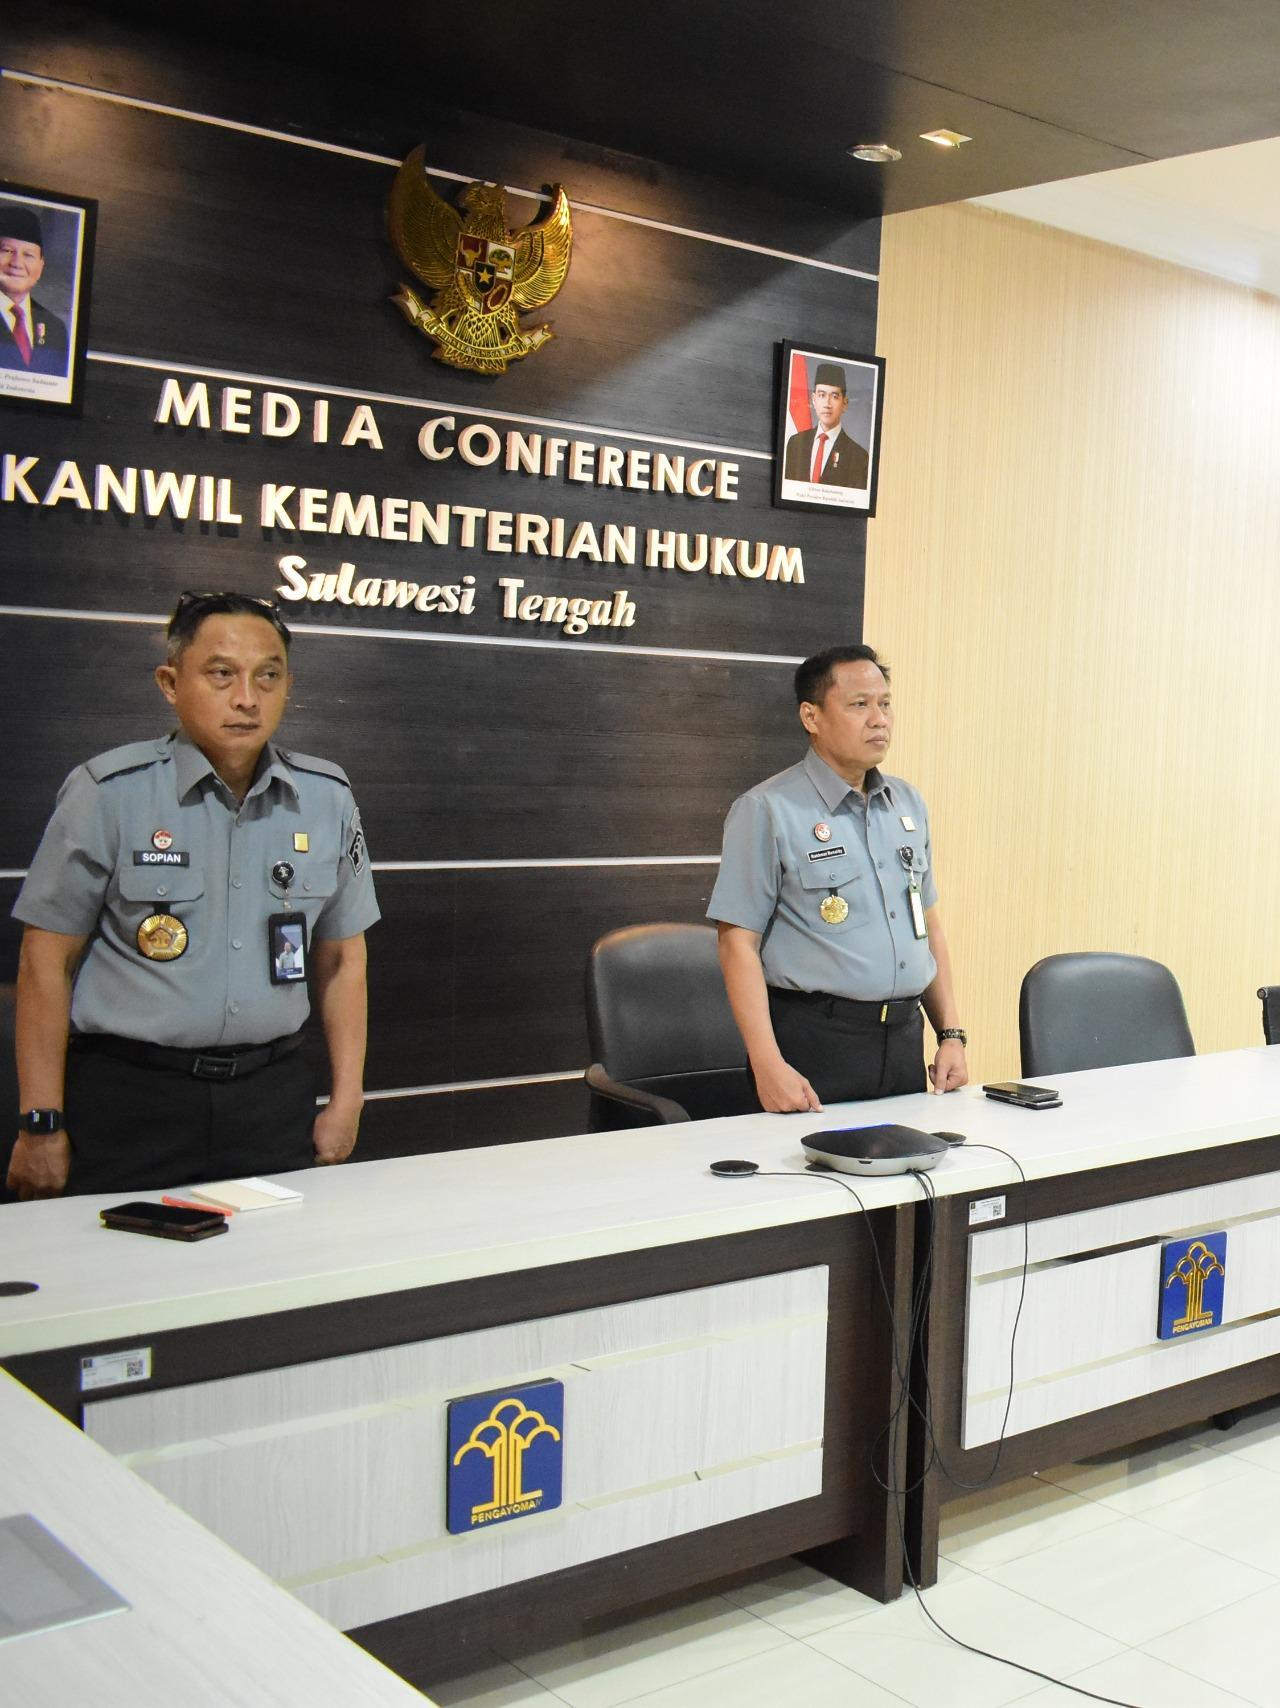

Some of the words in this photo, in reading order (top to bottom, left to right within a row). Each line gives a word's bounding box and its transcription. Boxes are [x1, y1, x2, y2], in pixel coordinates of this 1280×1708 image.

[154, 378, 384, 450] MEDIA
[418, 416, 739, 500] CONFERENCE
[1, 454, 243, 524] KANWIL
[260, 482, 636, 564] KEMENTERIAN
[645, 528, 806, 583] HUKUM
[276, 555, 476, 615] Sulawesi
[498, 577, 637, 635] Tengah
[142, 852, 181, 863] SOPIAN
[471, 1498, 543, 1525] PENGAYOMAN
